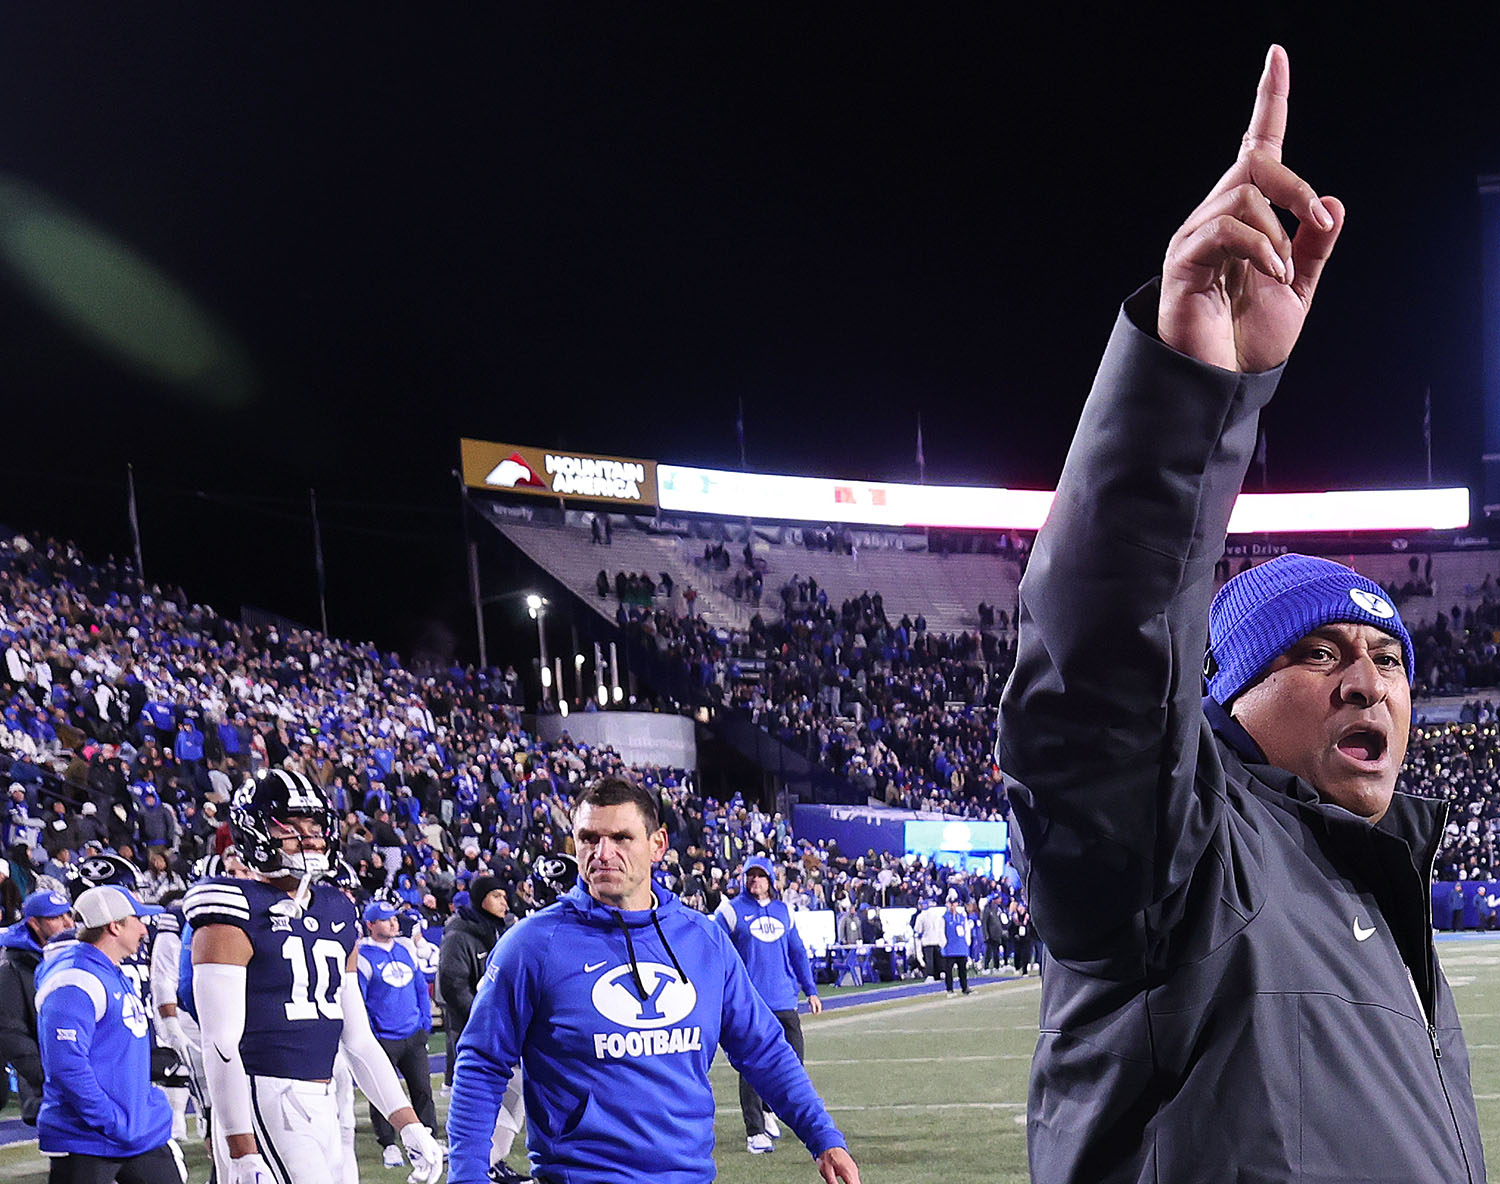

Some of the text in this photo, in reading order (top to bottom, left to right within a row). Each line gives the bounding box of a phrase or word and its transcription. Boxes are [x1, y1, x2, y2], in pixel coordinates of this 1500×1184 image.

[545, 454, 645, 483] MOUNTAIN
[282, 935, 347, 1021] 10
[609, 971, 677, 1020] Y
[593, 1026, 702, 1060] FOOTBALL
